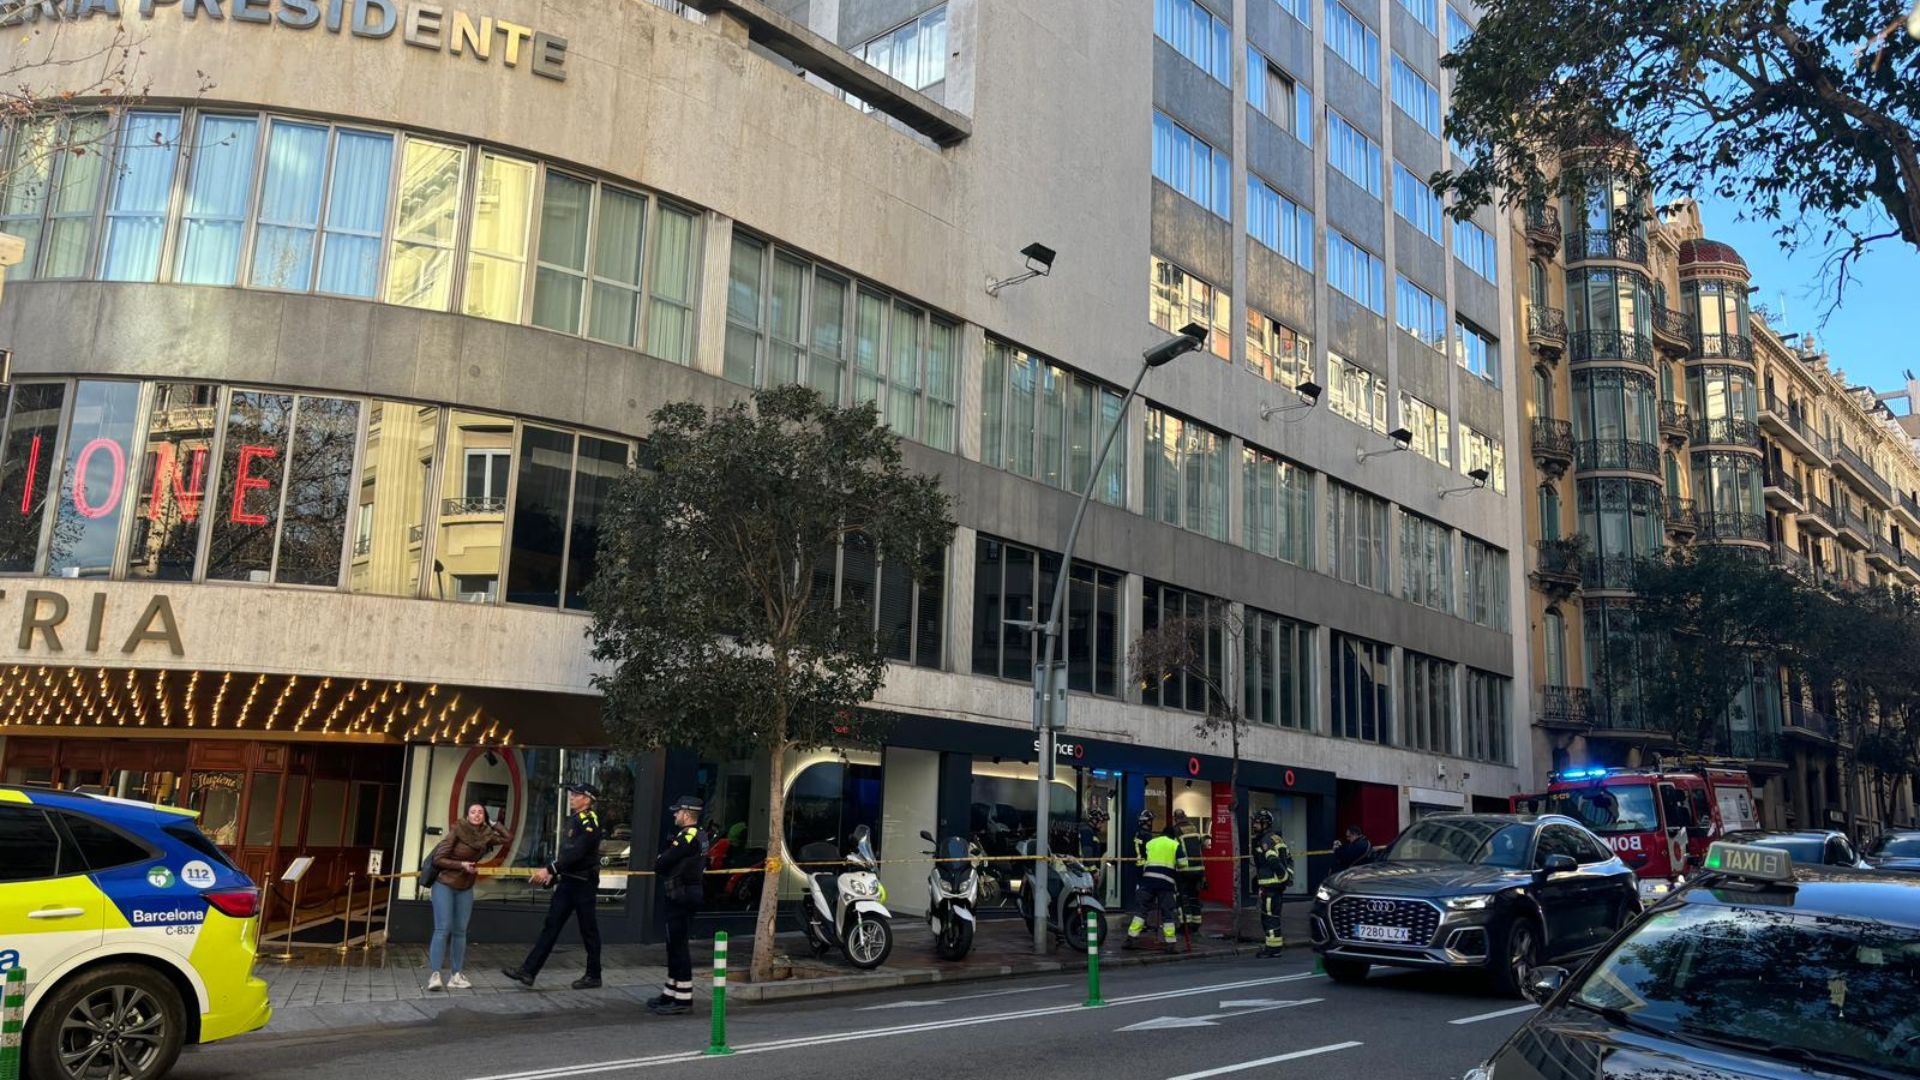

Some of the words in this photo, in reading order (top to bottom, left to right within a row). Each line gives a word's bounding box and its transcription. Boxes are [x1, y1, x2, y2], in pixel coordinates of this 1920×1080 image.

[0, 591, 185, 656] RIA
[1724, 849, 1760, 872] TAXI
[187, 868, 209, 879] 112
[132, 908, 204, 923] Barcelona
[165, 925, 196, 935] C-832
[1360, 926, 1385, 938] 7280
[1386, 928, 1406, 939] LZX
